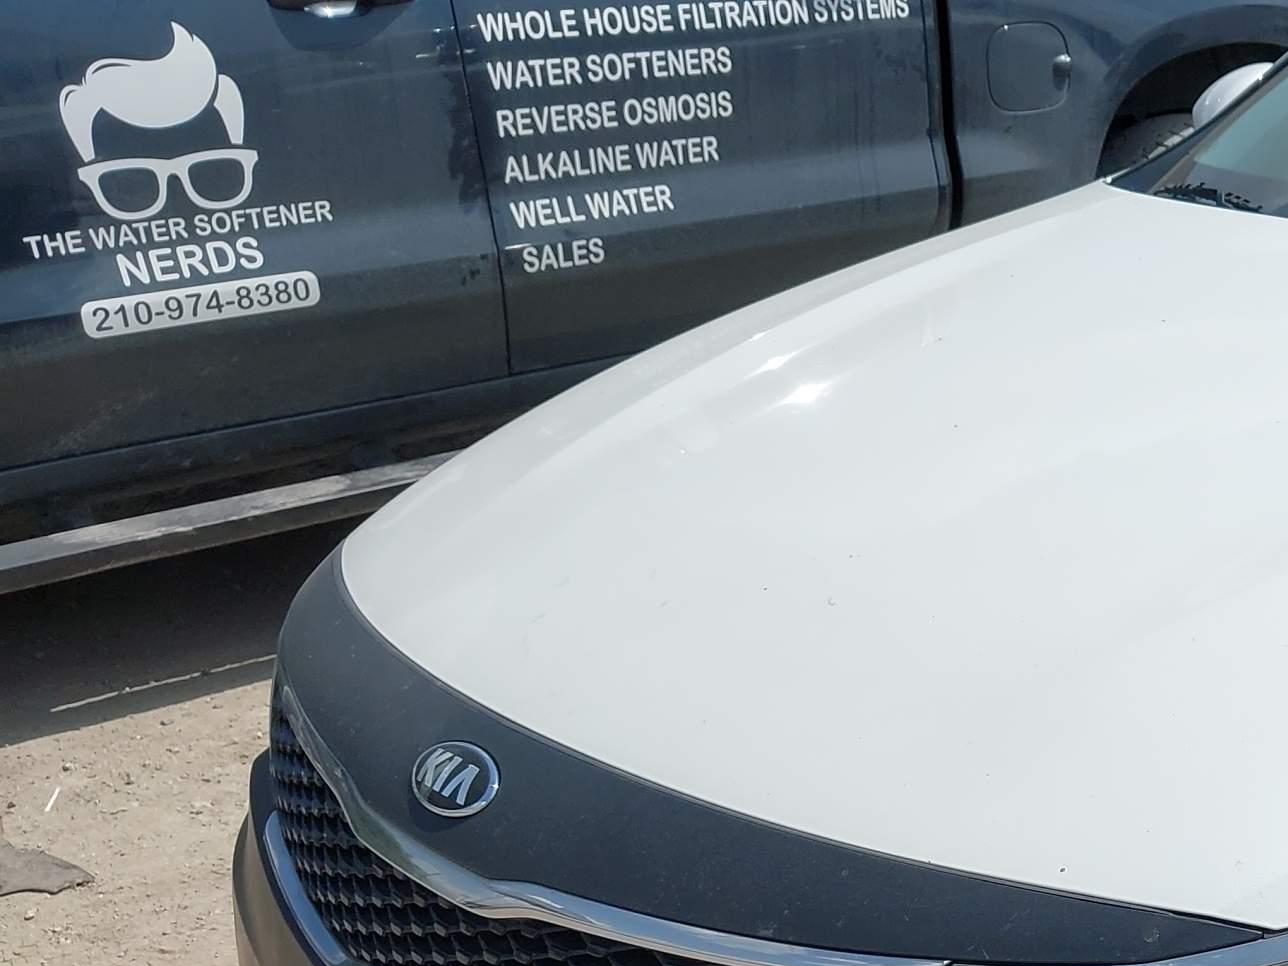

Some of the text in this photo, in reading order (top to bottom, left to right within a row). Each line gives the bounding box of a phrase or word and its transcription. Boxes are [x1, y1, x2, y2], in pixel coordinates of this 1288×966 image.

[477, 0, 909, 42] WHOLE HOUSE FILTRATION SYSTEMS
[487, 47, 732, 90] WATER SOFTENERS
[496, 91, 733, 138] REVERSE OSMOSIS
[504, 136, 720, 184] ALKALINE WATER
[23, 200, 334, 260] THE WATER SOFTENER
[510, 184, 675, 229] WELL WATER
[115, 236, 265, 288] NERDS
[522, 238, 605, 273] SALES
[92, 277, 311, 333] 210-974-8380
[416, 747, 480, 807] KIA
